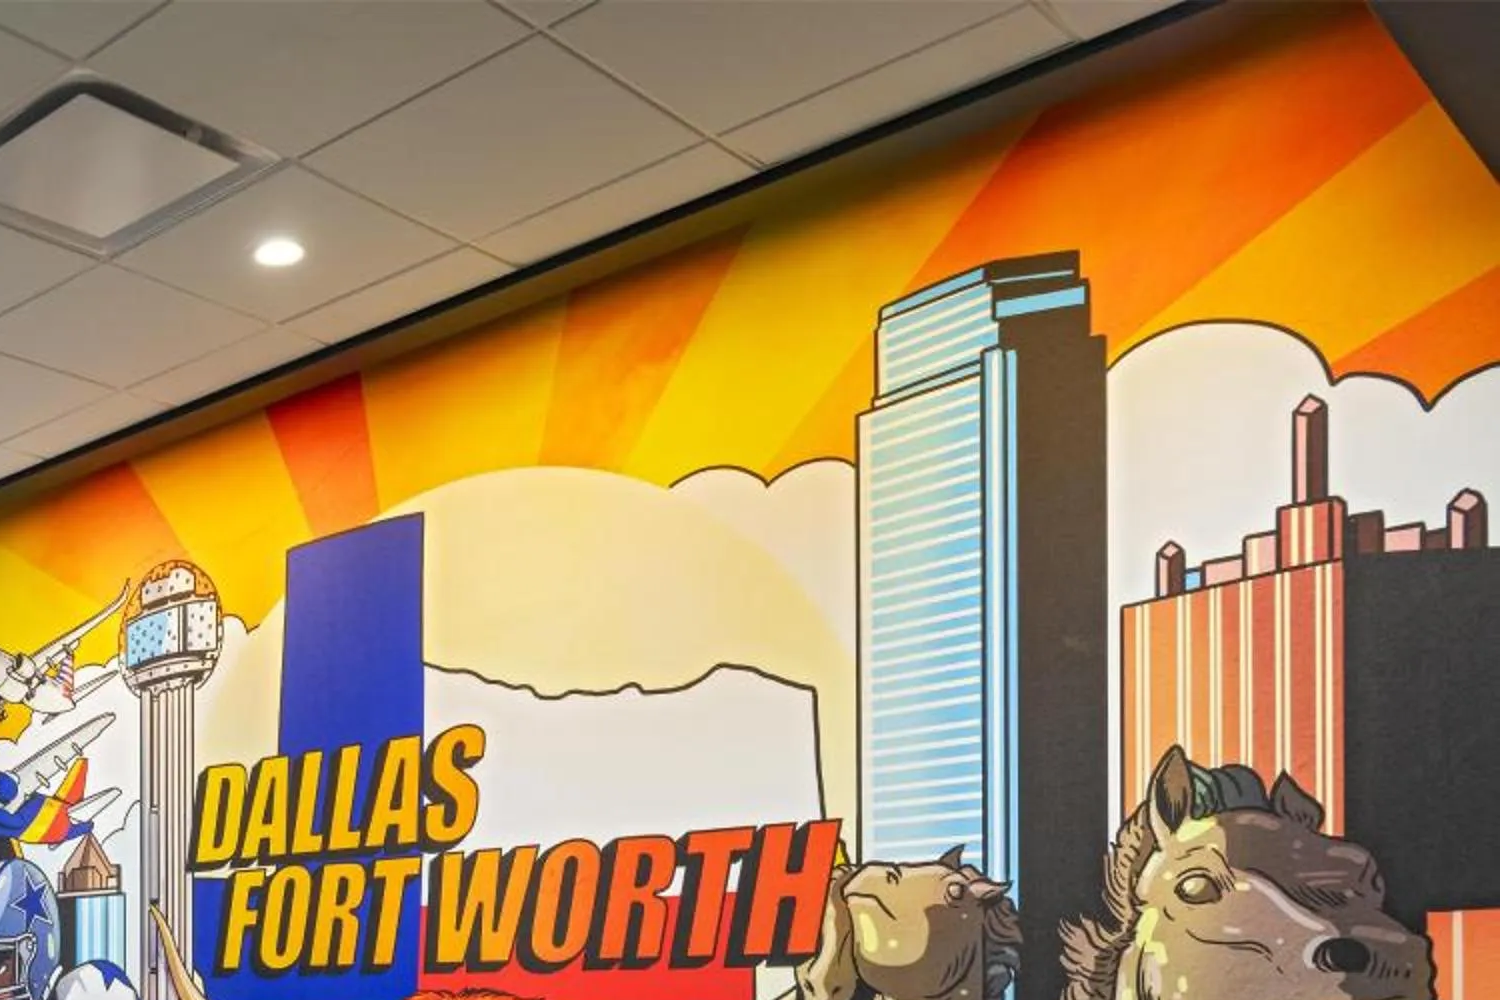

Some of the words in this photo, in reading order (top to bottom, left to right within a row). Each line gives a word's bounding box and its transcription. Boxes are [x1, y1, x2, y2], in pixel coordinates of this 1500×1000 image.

[191, 724, 486, 870] DALLAS
[217, 856, 423, 974] FORT
[426, 819, 842, 971] WORTH
